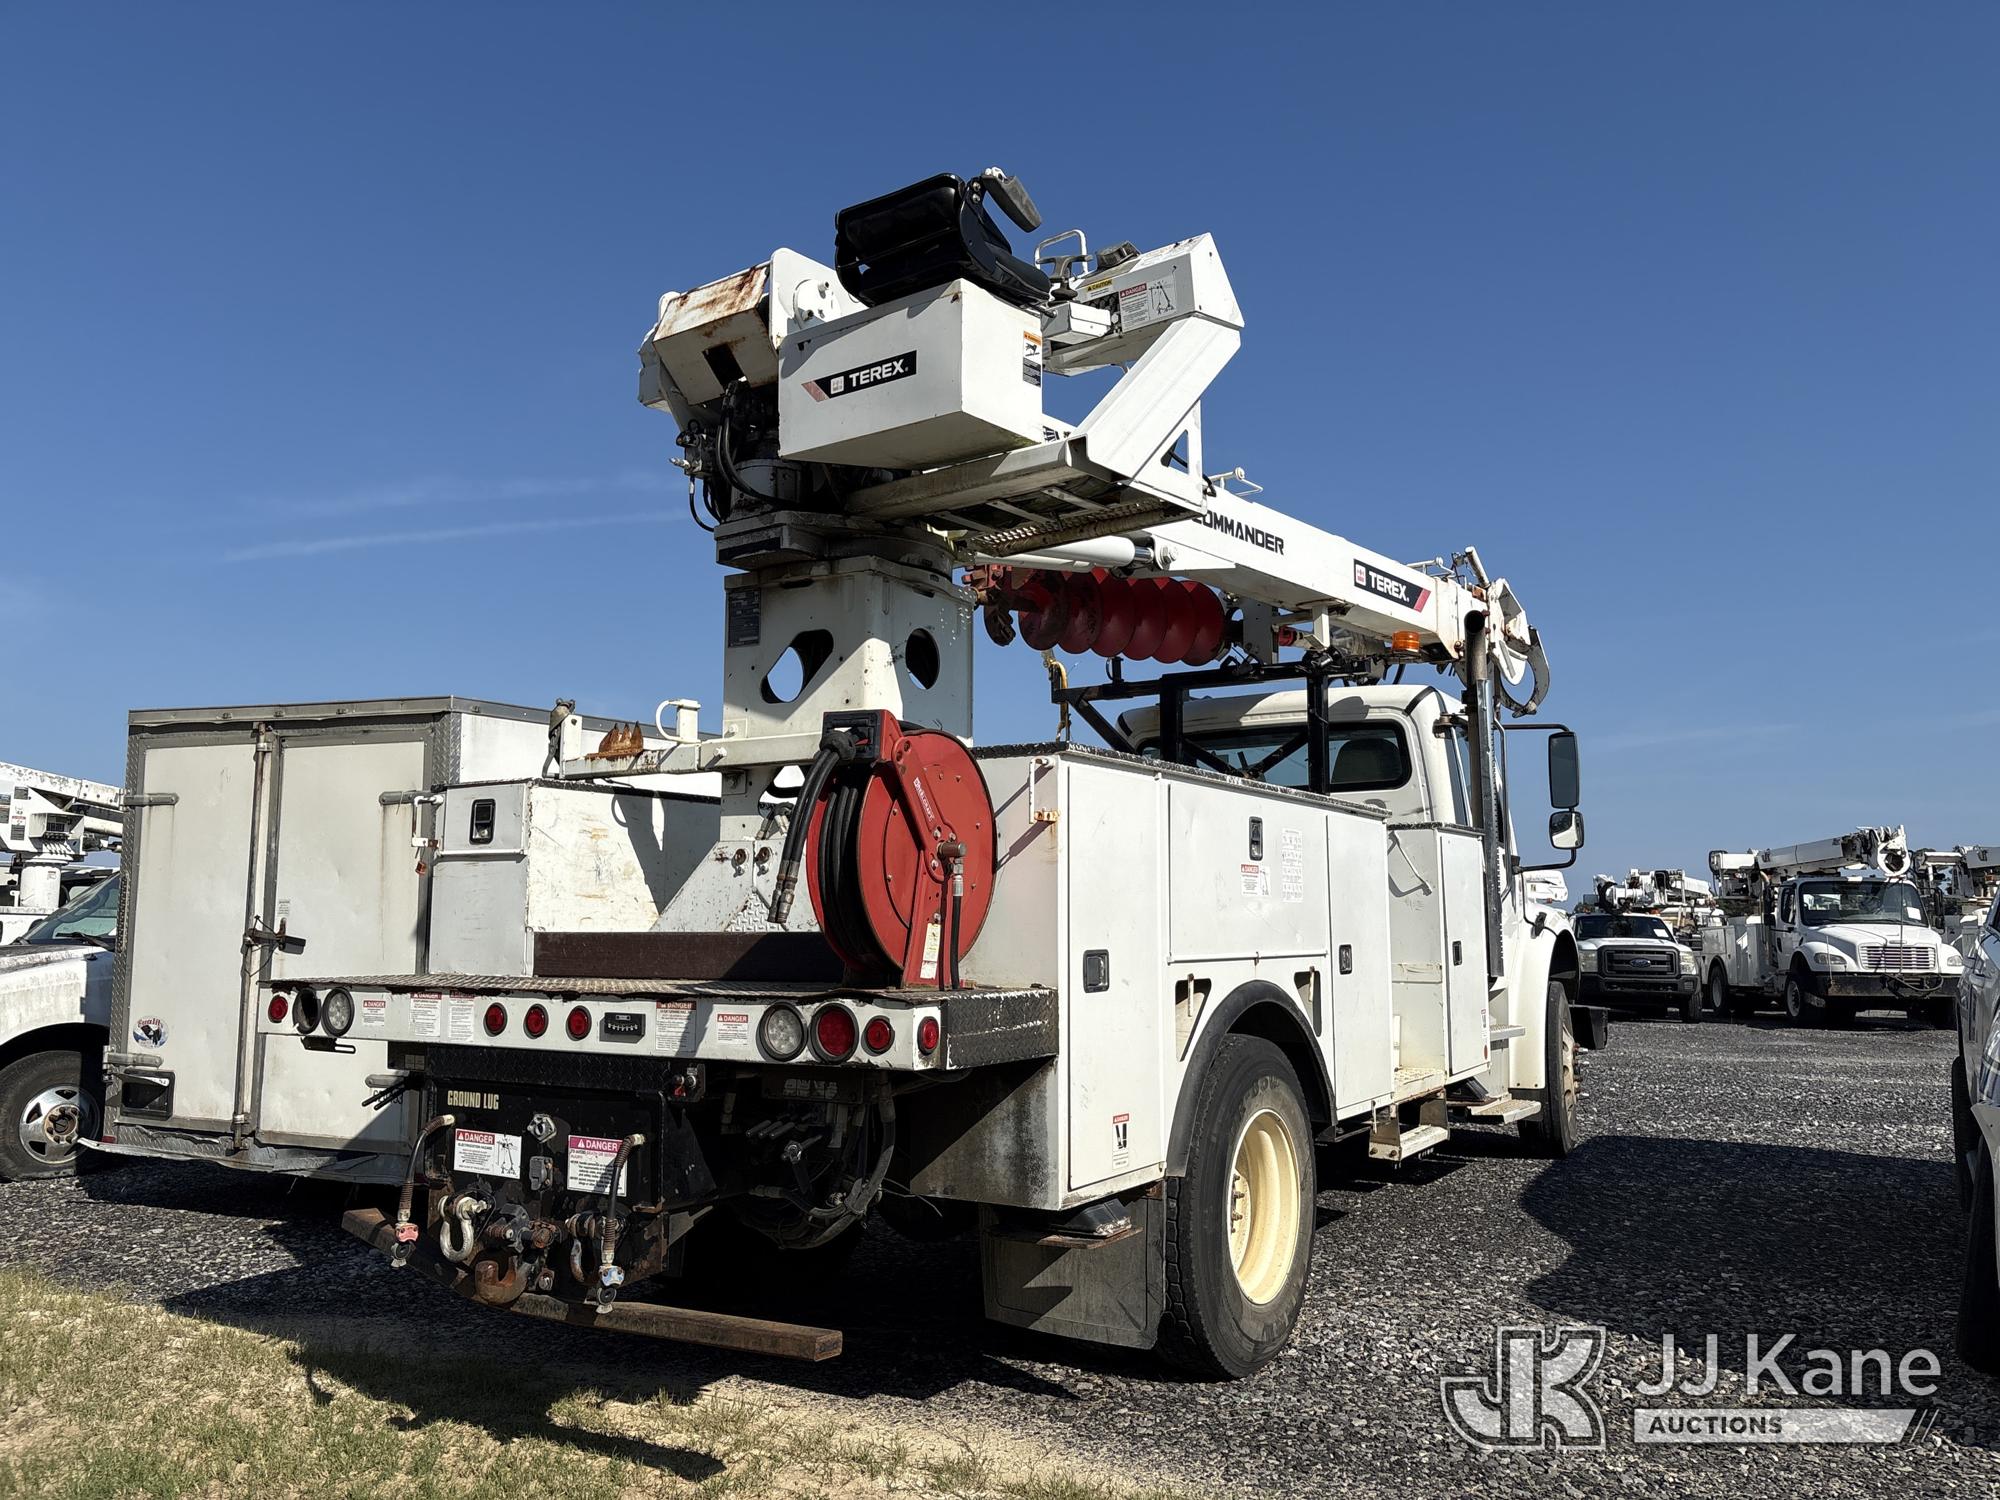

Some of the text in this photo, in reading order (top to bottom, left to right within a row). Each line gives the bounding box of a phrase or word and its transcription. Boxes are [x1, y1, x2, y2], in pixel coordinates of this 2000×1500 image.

[1125, 284, 1147, 296] DANGER
[848, 359, 905, 388] TEREX
[1368, 570, 1408, 602] TEREX
[447, 1090, 499, 1109] GROUND LUG
[464, 1132, 494, 1144] DANGER
[585, 1139, 618, 1152] DANGER
